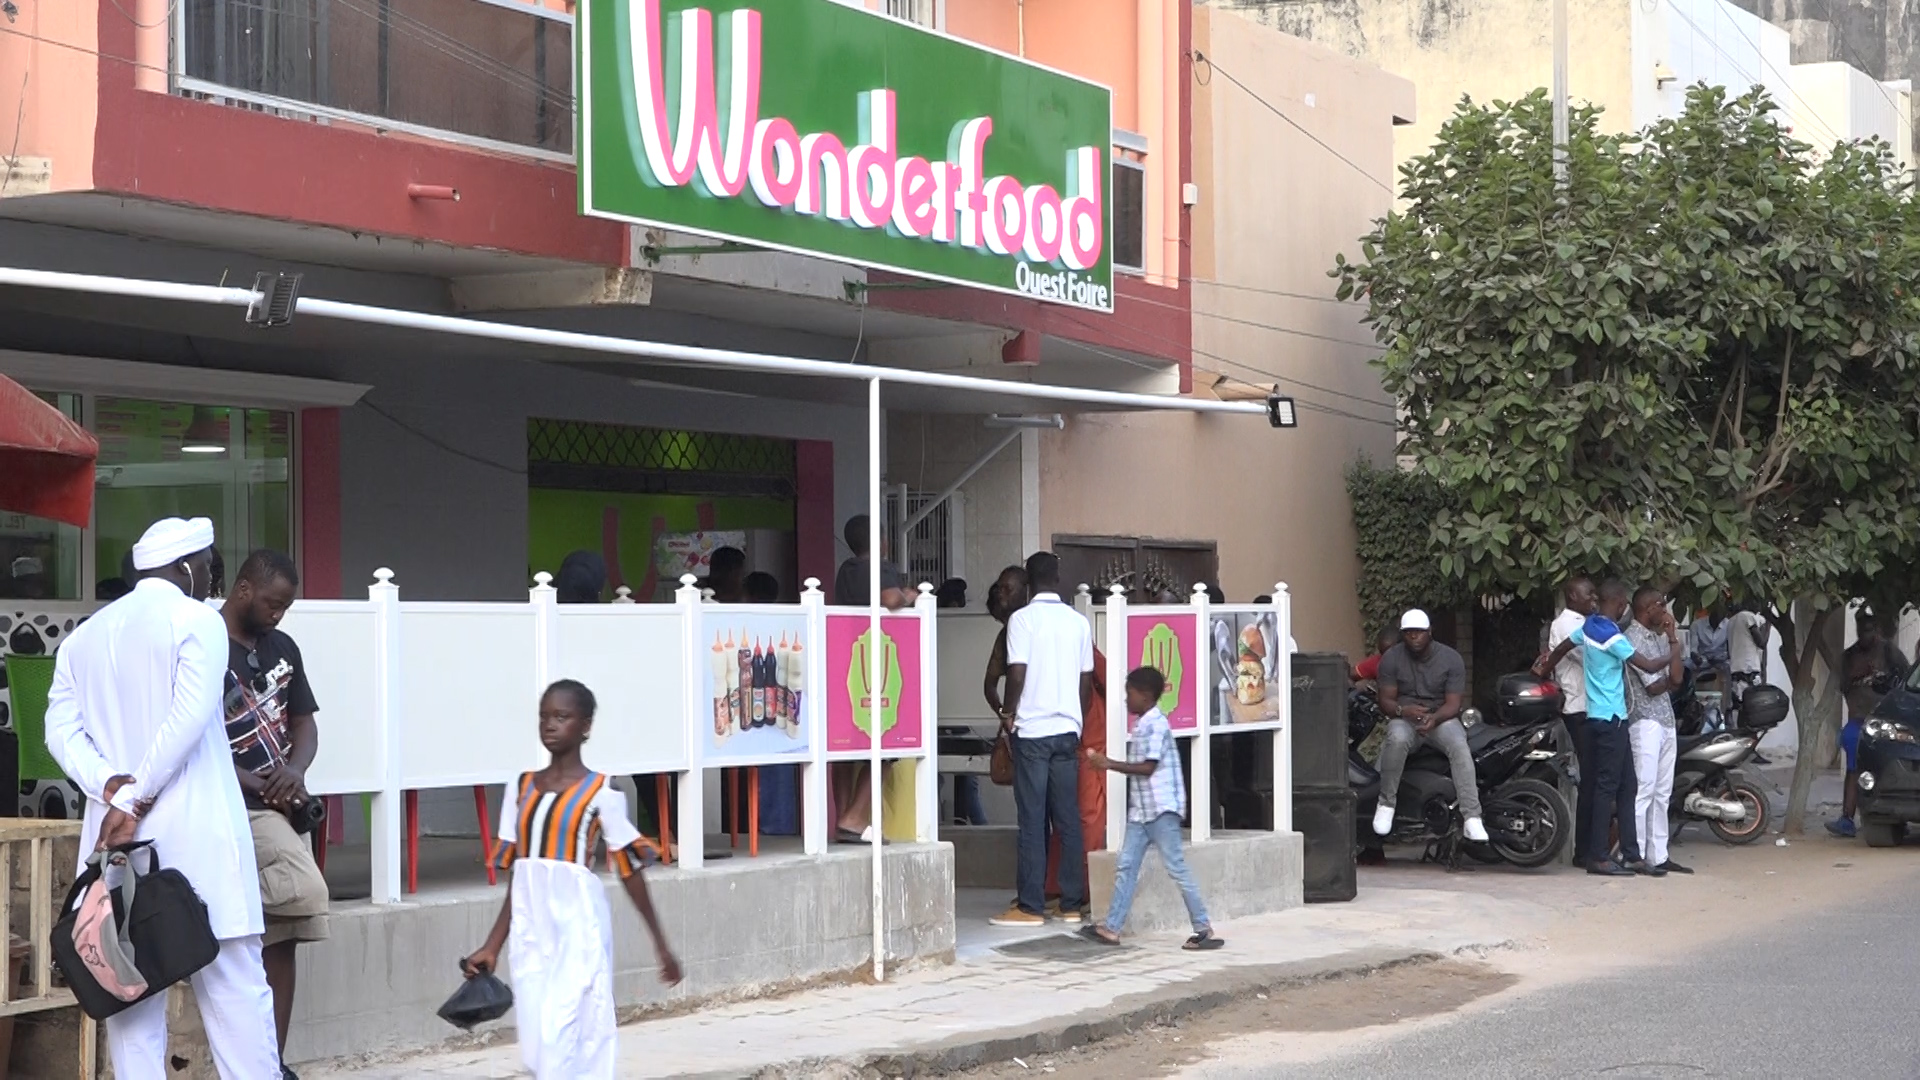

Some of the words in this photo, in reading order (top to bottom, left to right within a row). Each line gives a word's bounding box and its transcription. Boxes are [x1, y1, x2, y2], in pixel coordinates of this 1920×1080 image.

[617, 0, 1103, 270] Wonderfood
[1016, 261, 1066, 300] Ouest
[1067, 271, 1108, 308] Foire
